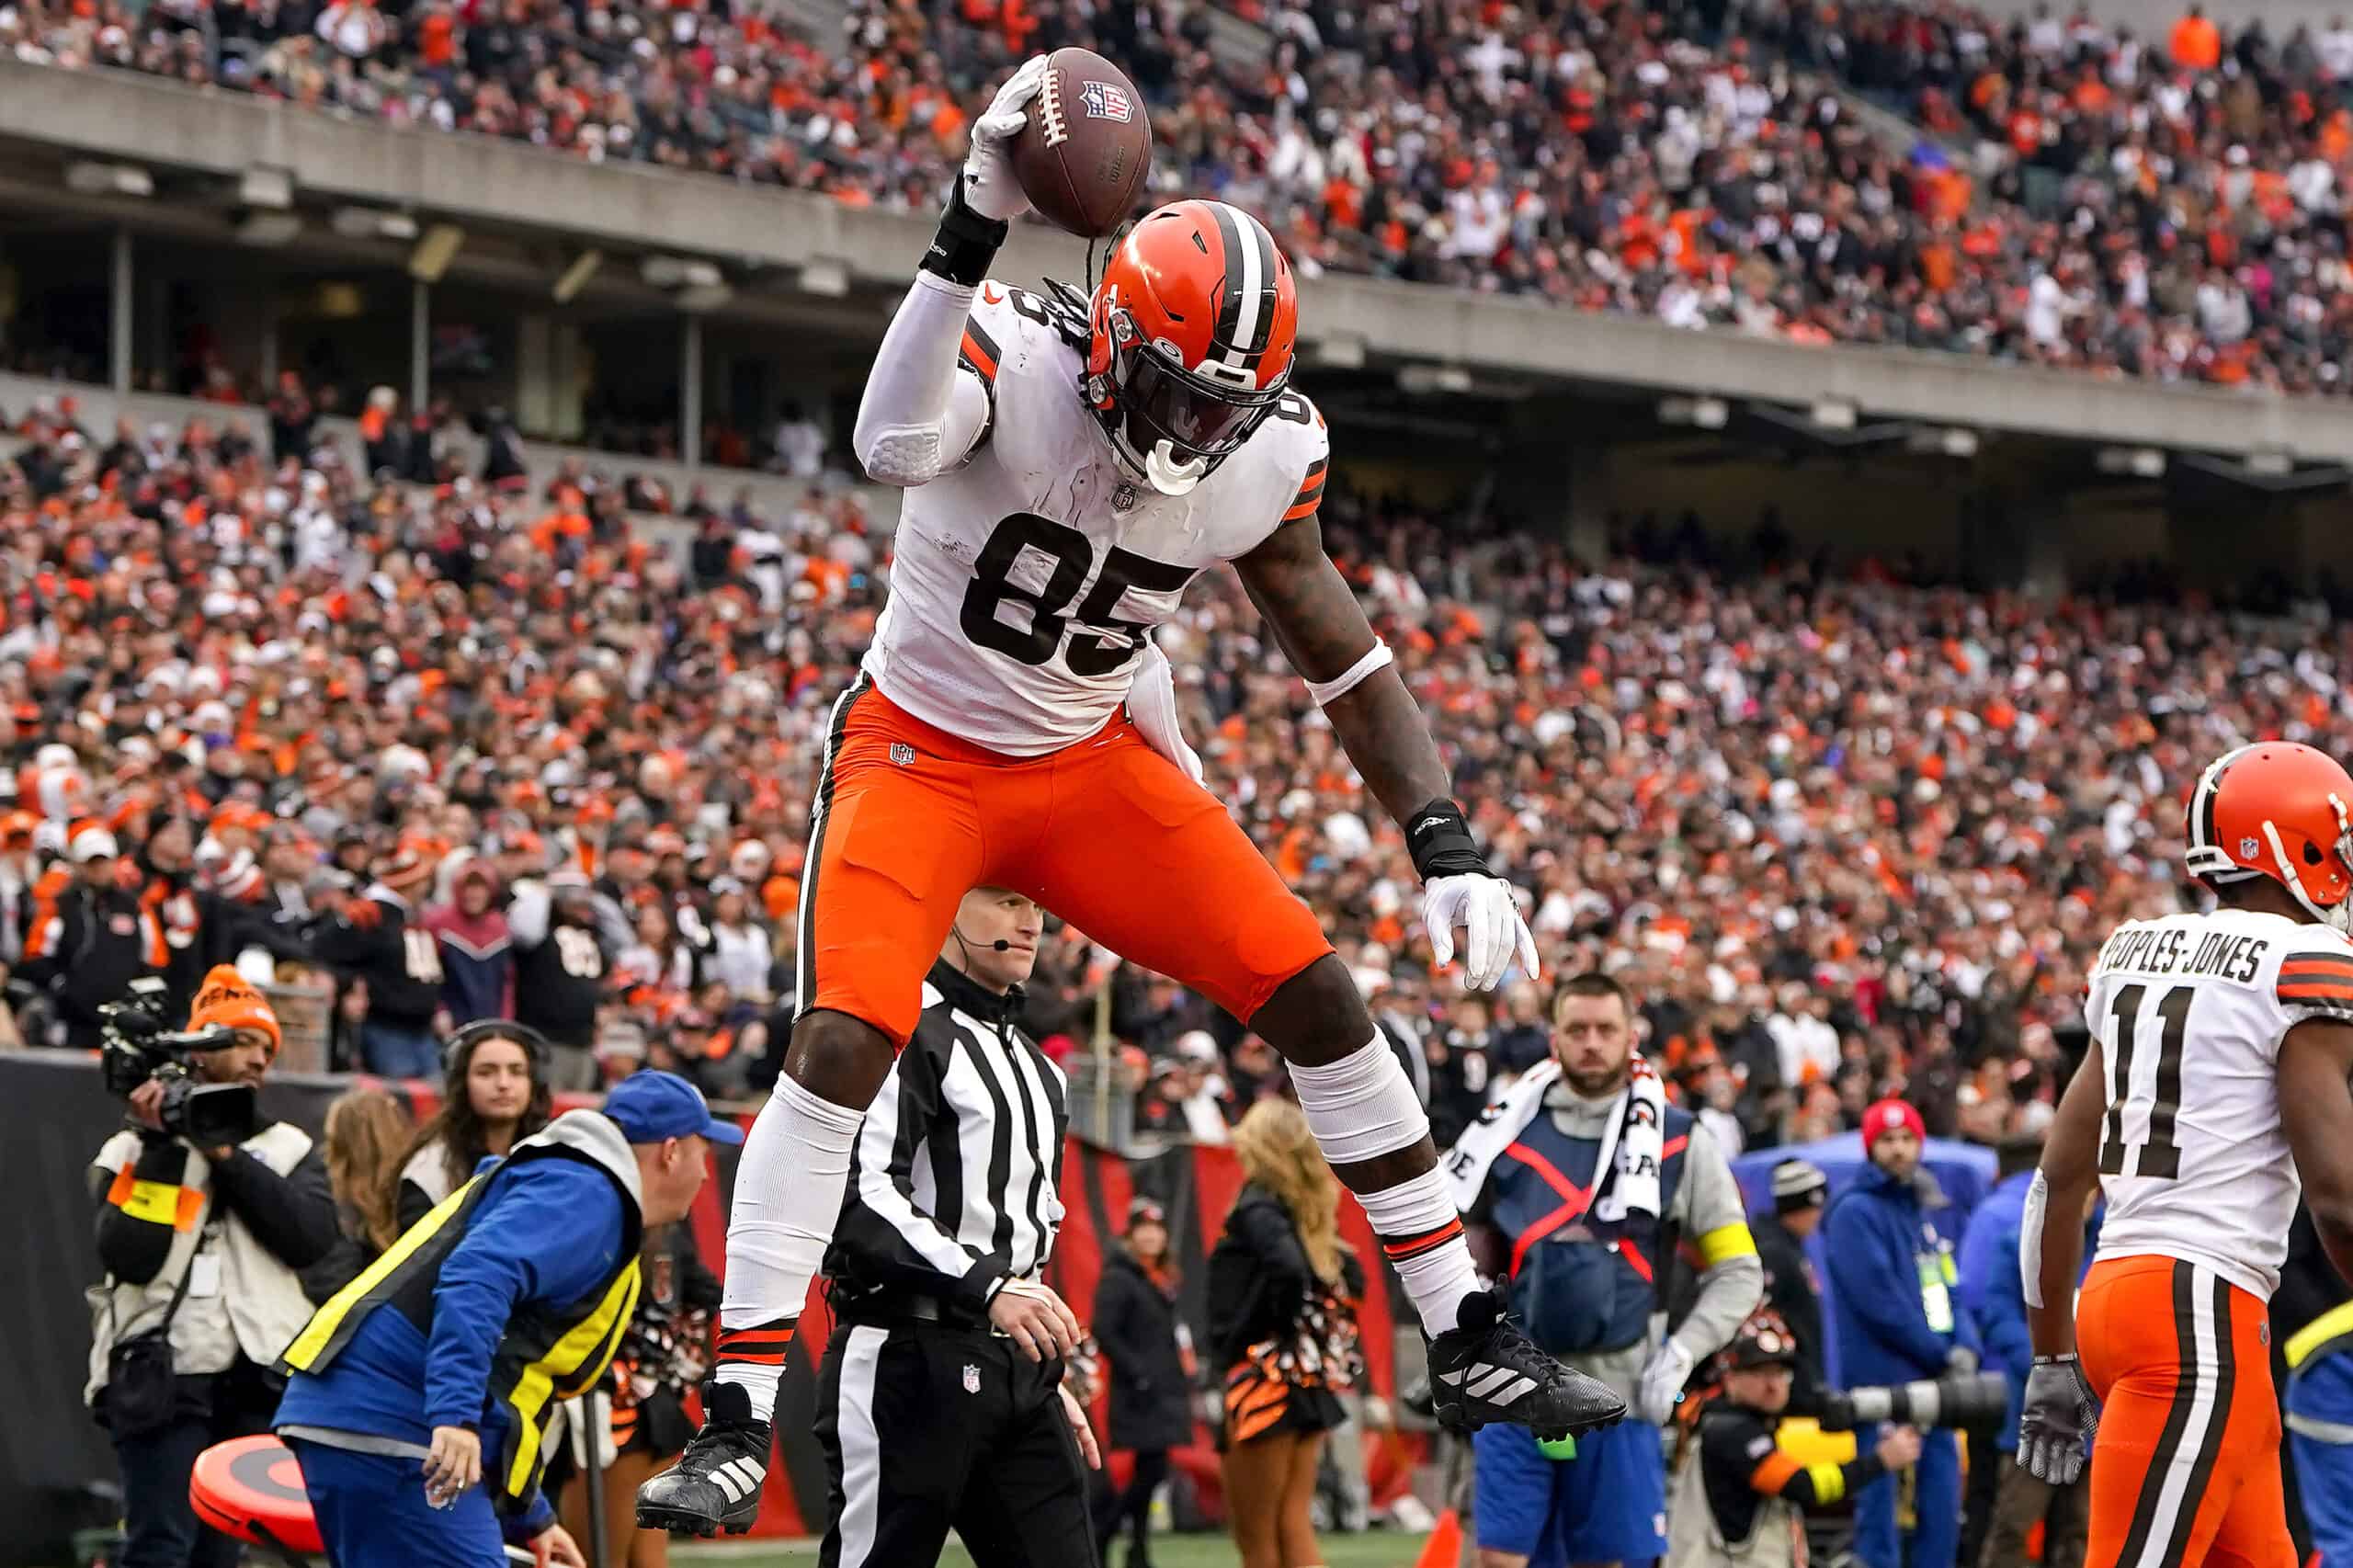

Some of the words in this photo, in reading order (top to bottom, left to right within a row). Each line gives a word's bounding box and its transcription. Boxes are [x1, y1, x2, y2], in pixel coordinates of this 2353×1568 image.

[960, 512, 1199, 676] 85
[2104, 929, 2268, 983] PEOPLES-JONES
[2099, 984, 2195, 1180] 11
